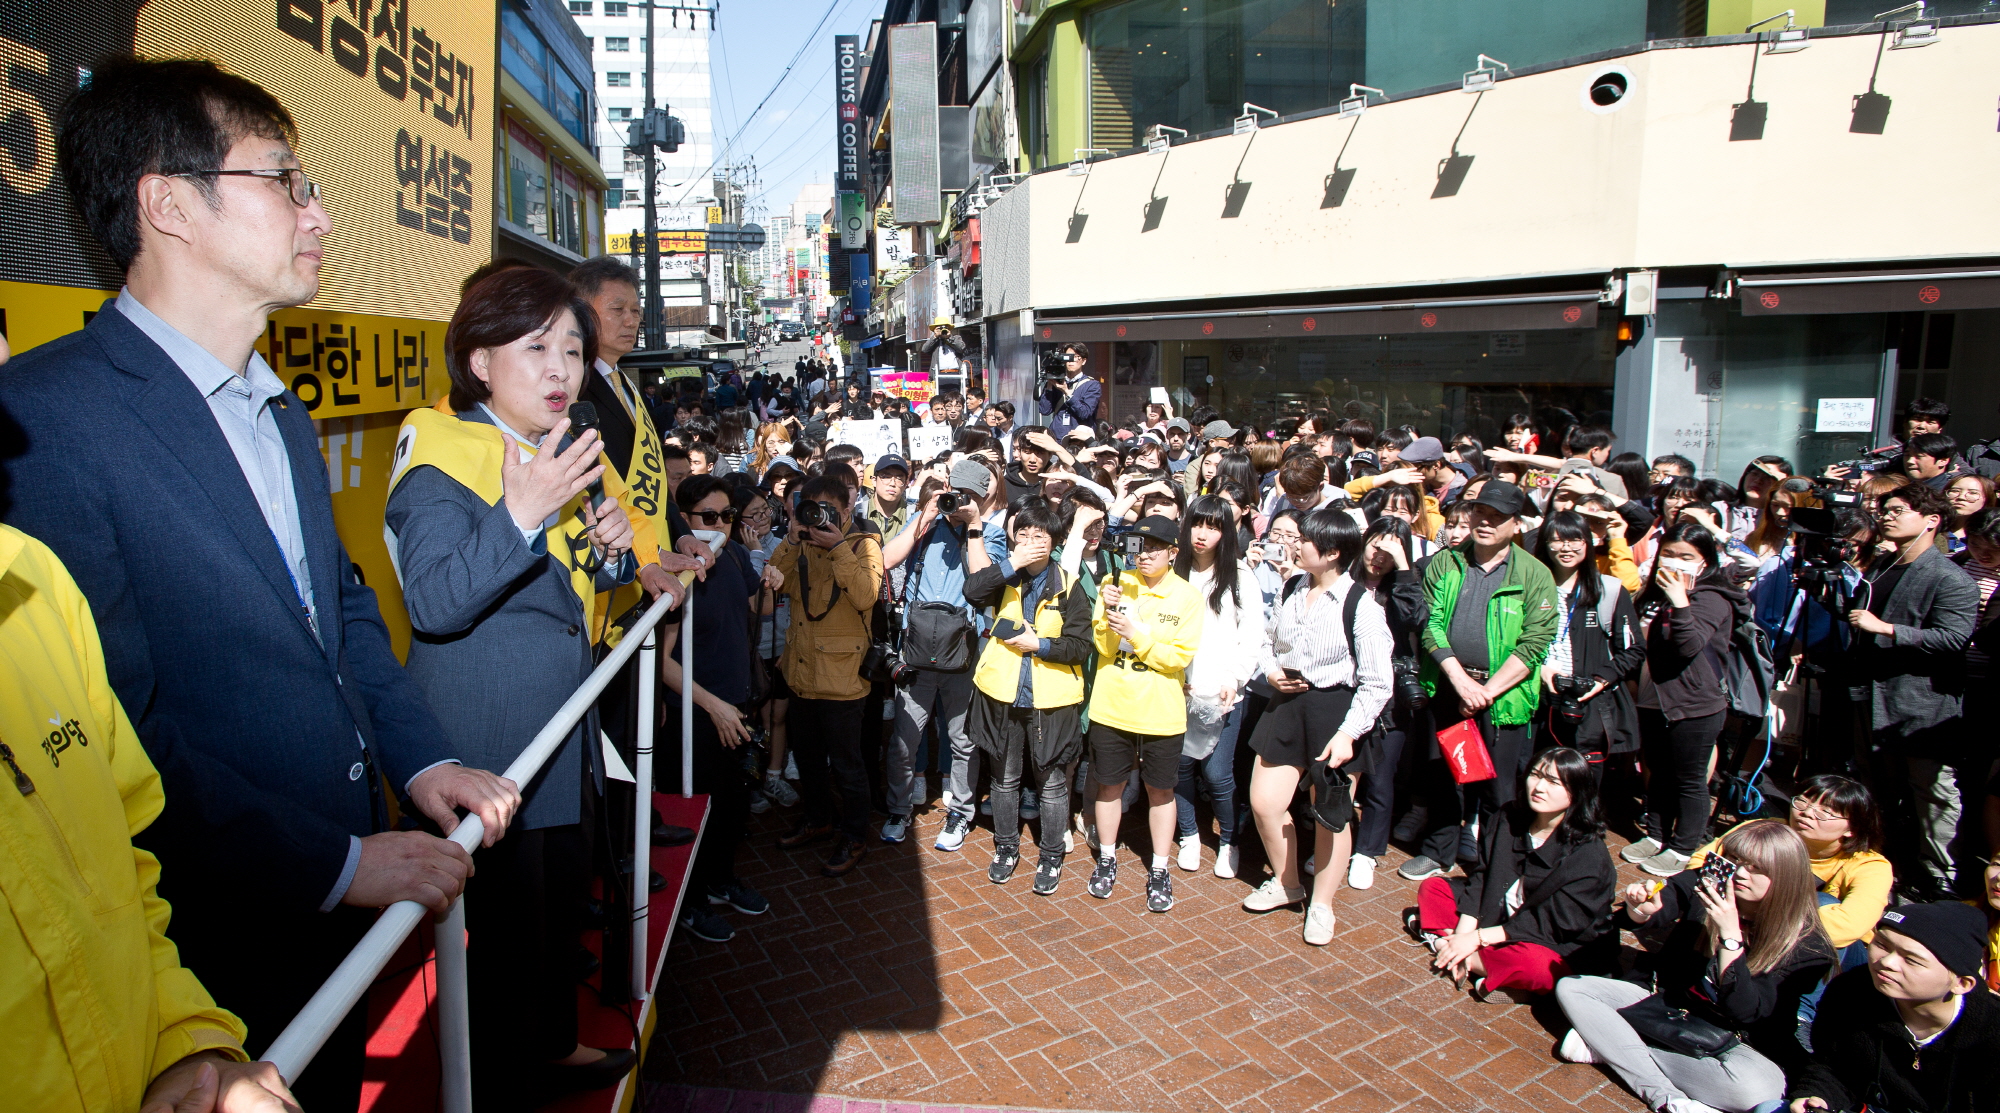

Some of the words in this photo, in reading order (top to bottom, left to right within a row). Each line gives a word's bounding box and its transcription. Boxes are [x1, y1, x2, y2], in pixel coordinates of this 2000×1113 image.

[840, 43, 855, 103] HOLLYS
[842, 122, 857, 181] COFFEE
[395, 128, 472, 245] 연설중
[374, 329, 428, 402] 나라
[1357, 451, 1373, 460] USA
[1158, 612, 1180, 626] 정의당
[41, 718, 88, 769] 정의당
